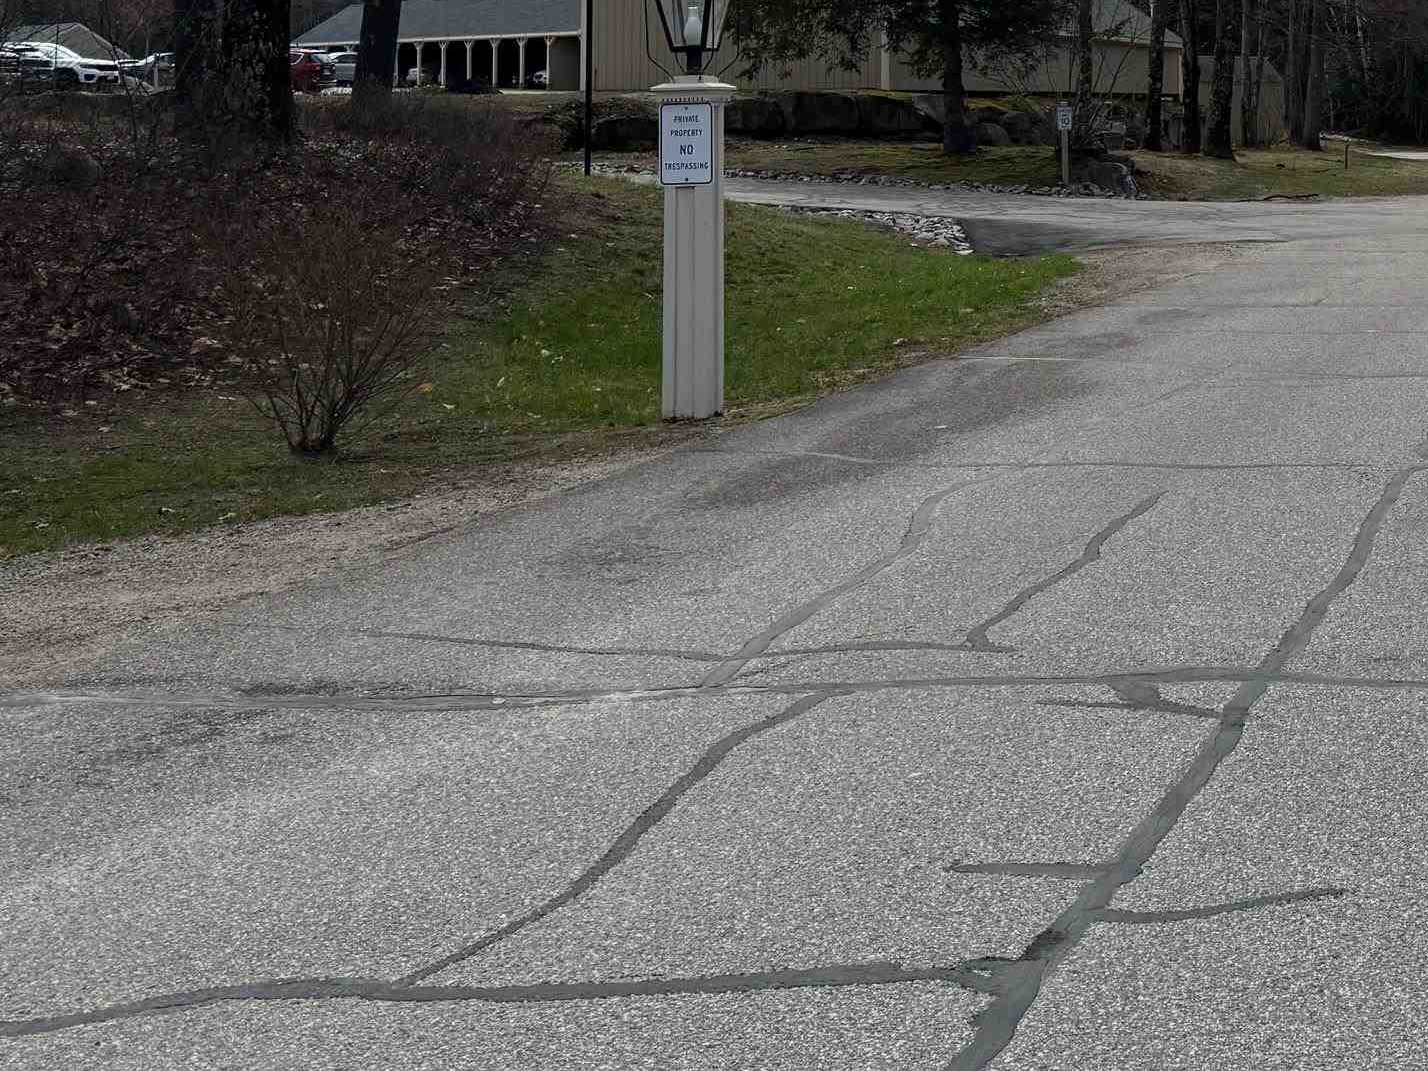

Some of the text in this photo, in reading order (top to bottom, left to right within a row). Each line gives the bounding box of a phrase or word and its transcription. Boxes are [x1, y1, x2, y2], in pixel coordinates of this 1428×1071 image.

[673, 114, 700, 123] PRIVATE
[670, 129, 703, 137] PROPERTY
[680, 144, 694, 155] NO
[664, 162, 709, 170] TRESPASSING
